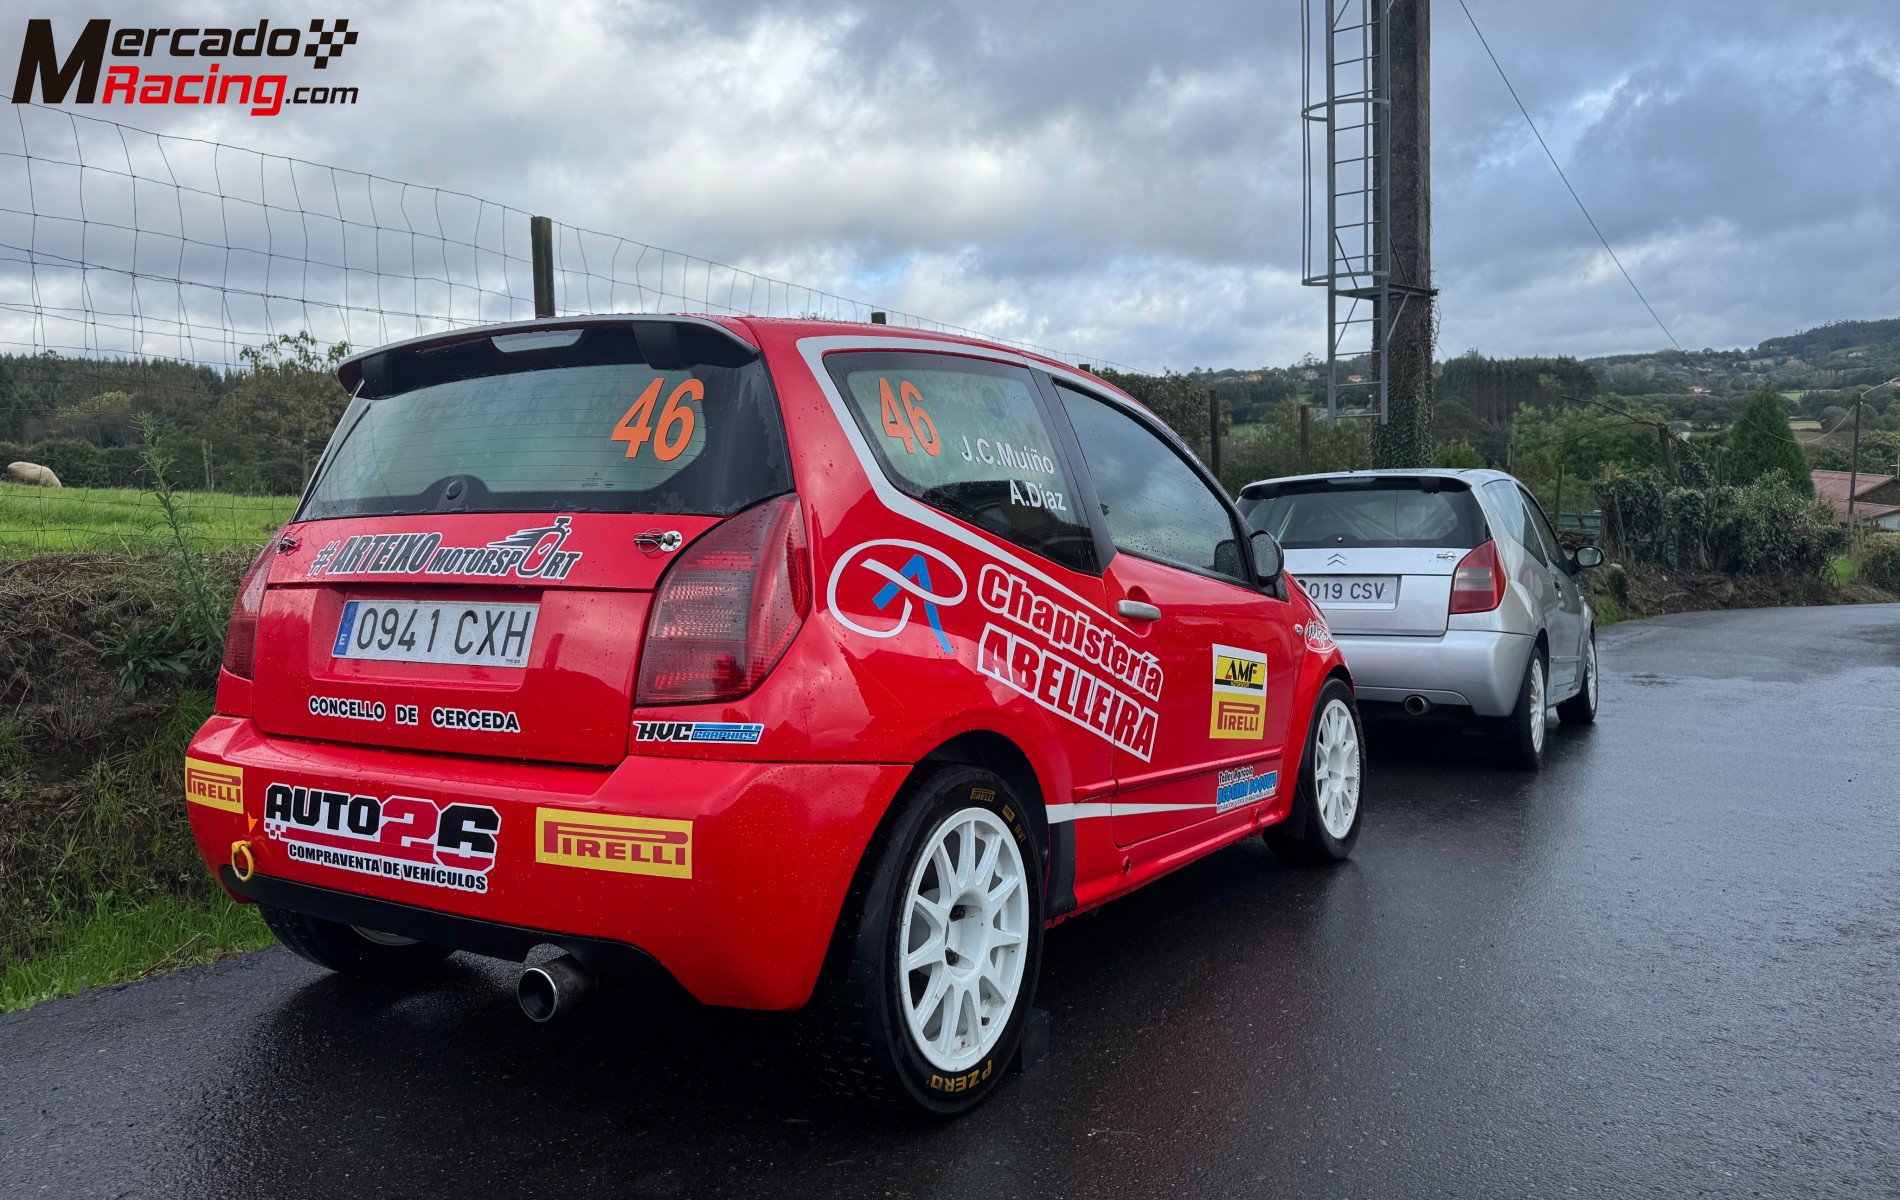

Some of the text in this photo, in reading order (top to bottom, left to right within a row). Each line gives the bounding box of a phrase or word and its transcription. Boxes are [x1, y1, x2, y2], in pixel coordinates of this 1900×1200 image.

[611, 377, 704, 461] 46
[879, 377, 941, 457] 46
[309, 532, 440, 576] #ARTEIXO
[1298, 579, 1385, 600] 019 CSV
[339, 607, 531, 658] E 0941 CXH
[1225, 659, 1258, 683] AMF
[977, 622, 1159, 763] ABELLEIRA
[309, 696, 519, 732] CONCELLO DE CERCEDA
[634, 722, 758, 741] HVC GRAPHICS
[1217, 701, 1260, 731] PIRELLI
[187, 767, 241, 804] PIRELLI
[970, 787, 996, 803] PIRELLI
[544, 820, 689, 866] PIRELLI
[289, 843, 486, 891] COMPRAVENTA DE VEHÍCULOS
